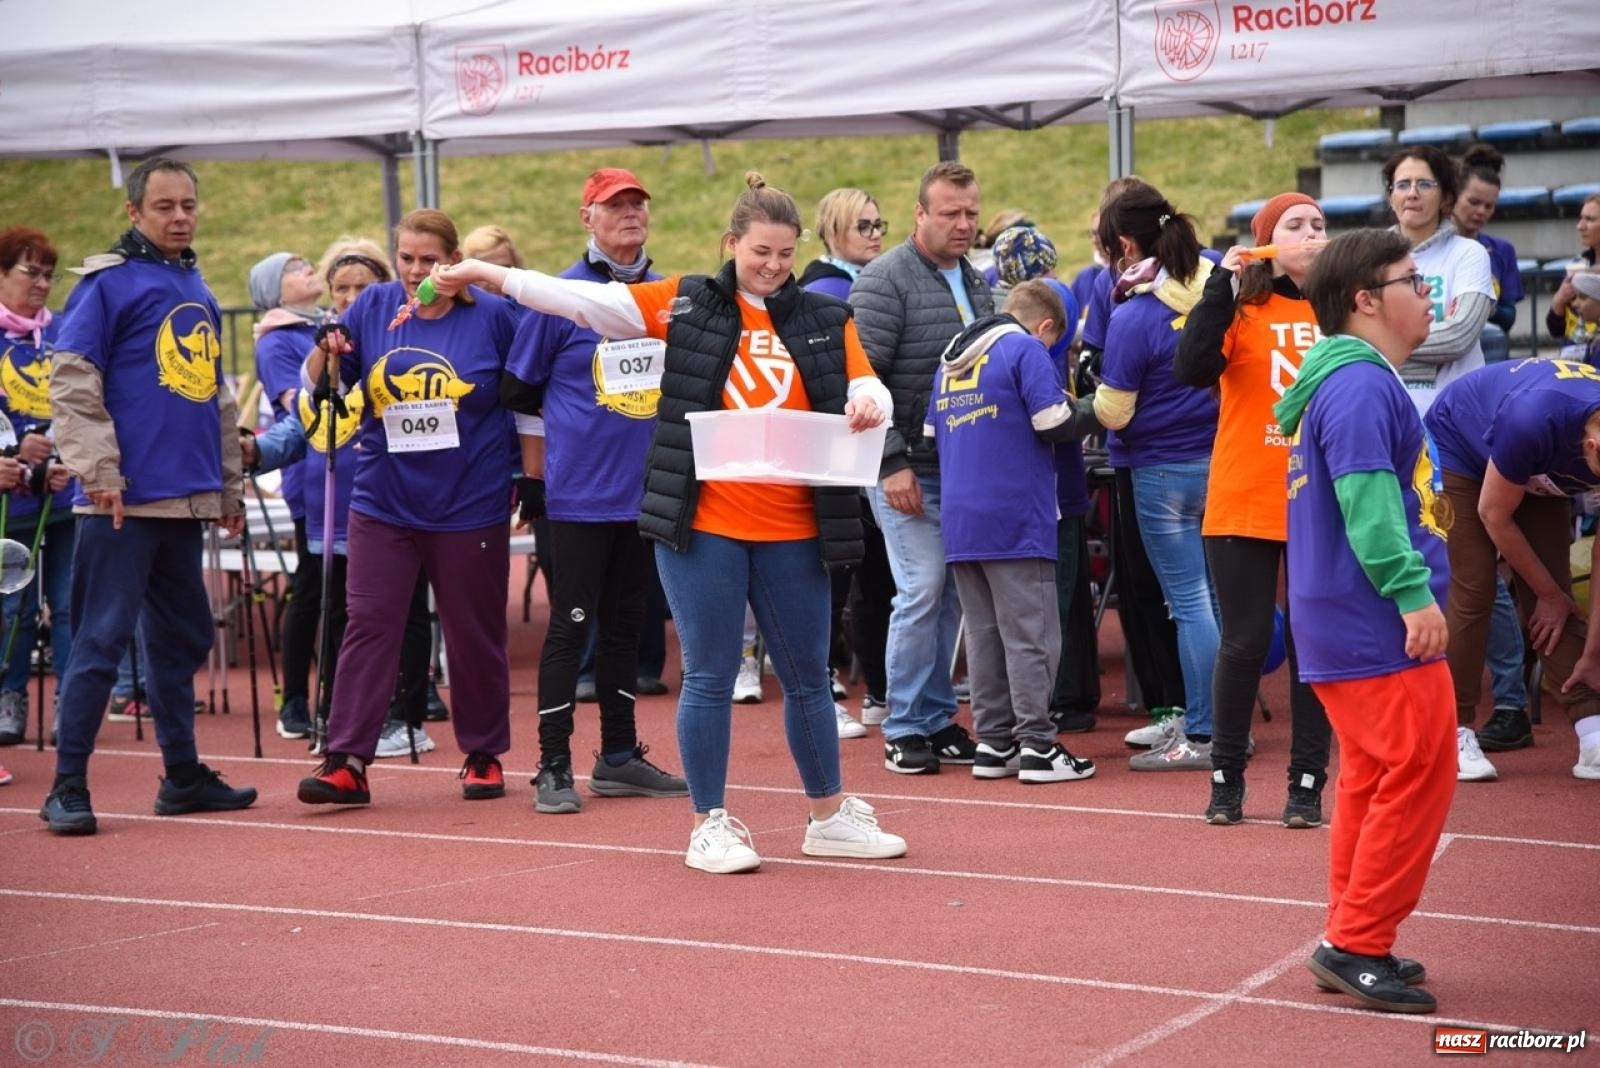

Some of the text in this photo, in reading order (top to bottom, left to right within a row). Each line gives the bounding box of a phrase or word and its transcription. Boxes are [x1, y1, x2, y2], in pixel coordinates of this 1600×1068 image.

[517, 44, 630, 76] Racibórz
[1229, 41, 1269, 63] 1217
[619, 356, 653, 375] 037
[950, 393, 984, 408] SYSTEM
[401, 416, 439, 434] 049
